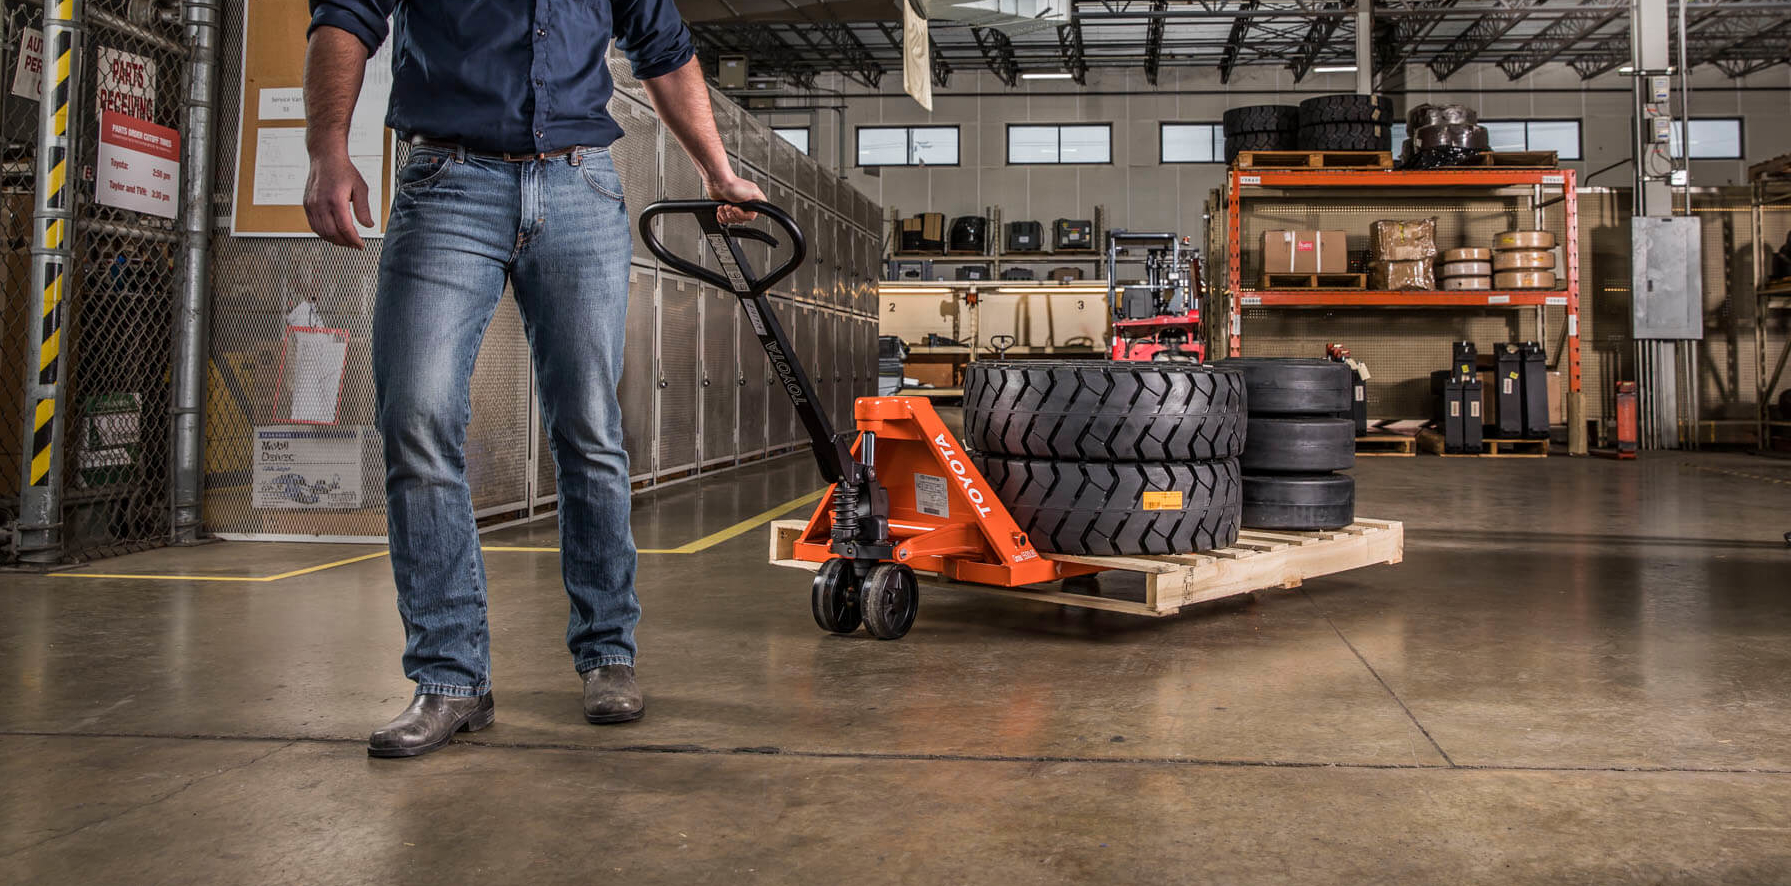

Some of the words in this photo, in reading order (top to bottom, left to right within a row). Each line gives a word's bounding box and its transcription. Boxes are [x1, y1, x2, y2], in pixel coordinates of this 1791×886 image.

[113, 59, 144, 88] PARTS
[100, 89, 153, 123] RECEIVING
[109, 180, 125, 191] Taylor
[126, 185, 136, 193] and
[889, 302, 896, 312] 2
[1077, 300, 1085, 311] 3
[766, 340, 807, 405] TOYOTA
[935, 433, 991, 518] TOYOTA
